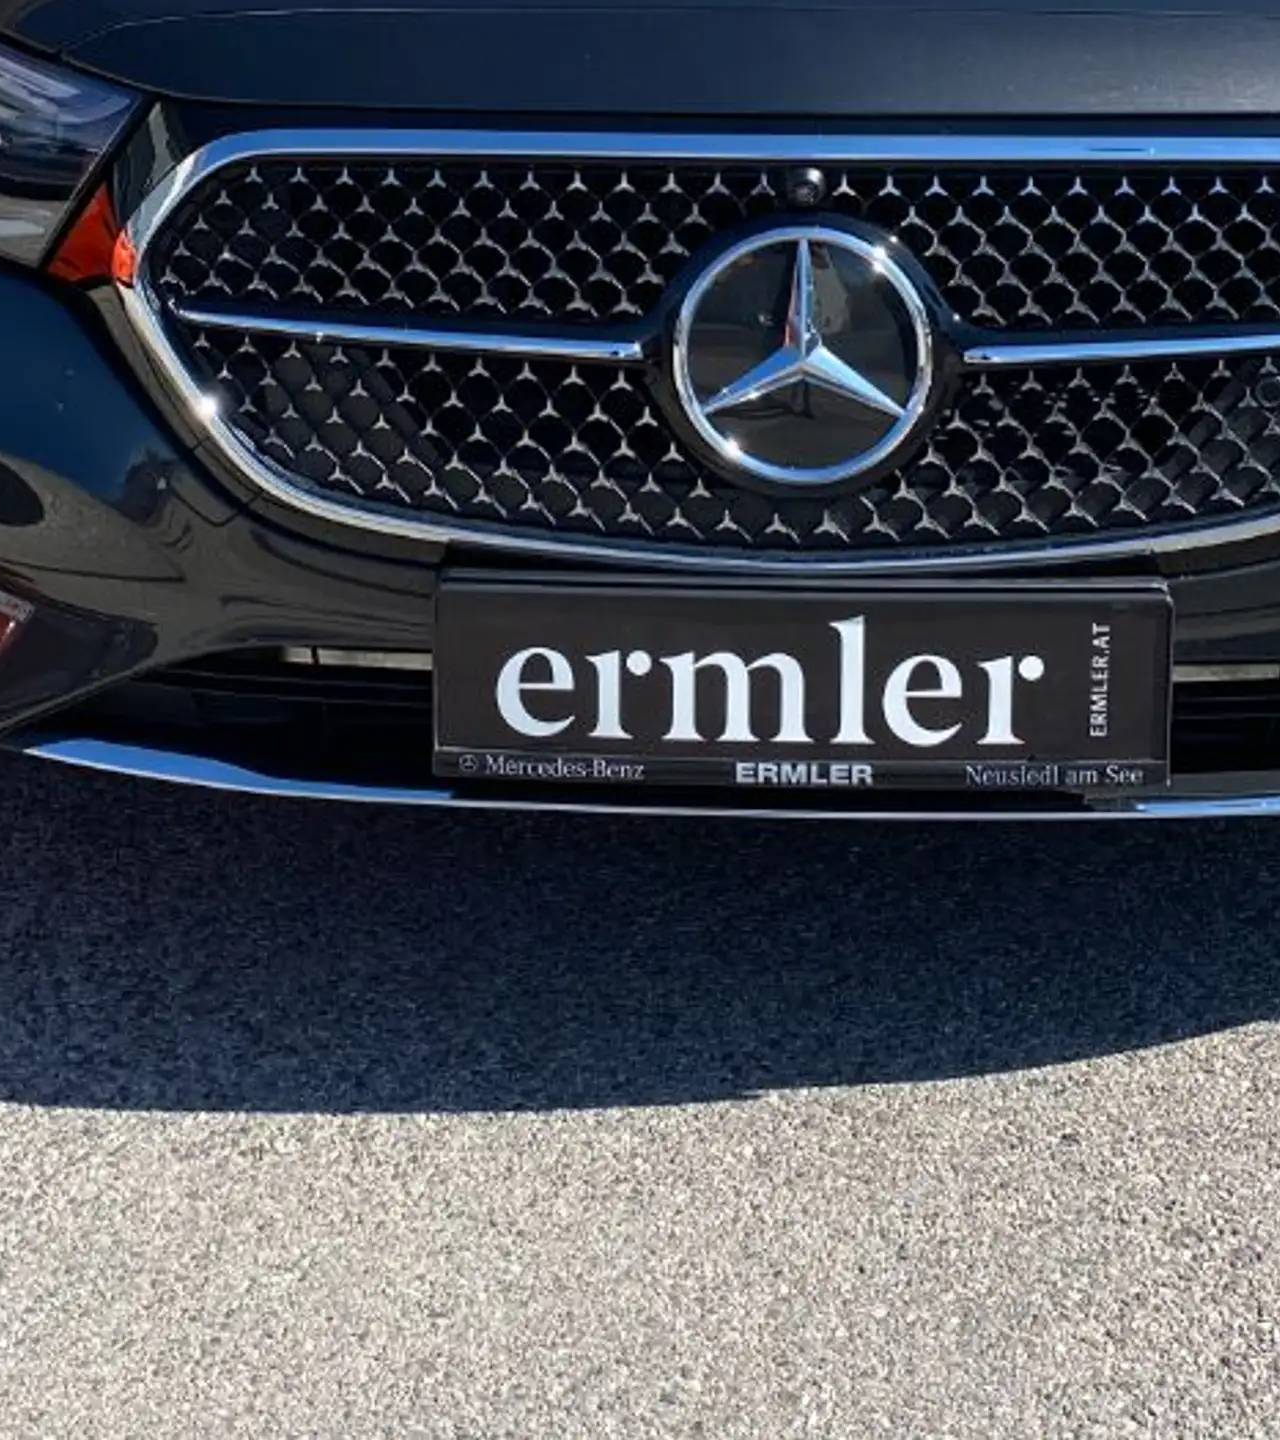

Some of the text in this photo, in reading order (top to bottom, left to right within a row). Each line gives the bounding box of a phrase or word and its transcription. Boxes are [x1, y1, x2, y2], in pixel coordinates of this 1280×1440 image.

[495, 614, 1045, 747] ermler
[1089, 622, 1112, 738] ERMLER.AT
[484, 754, 1145, 787] Mercedes-Benz ERMLER Neusiedl am See
